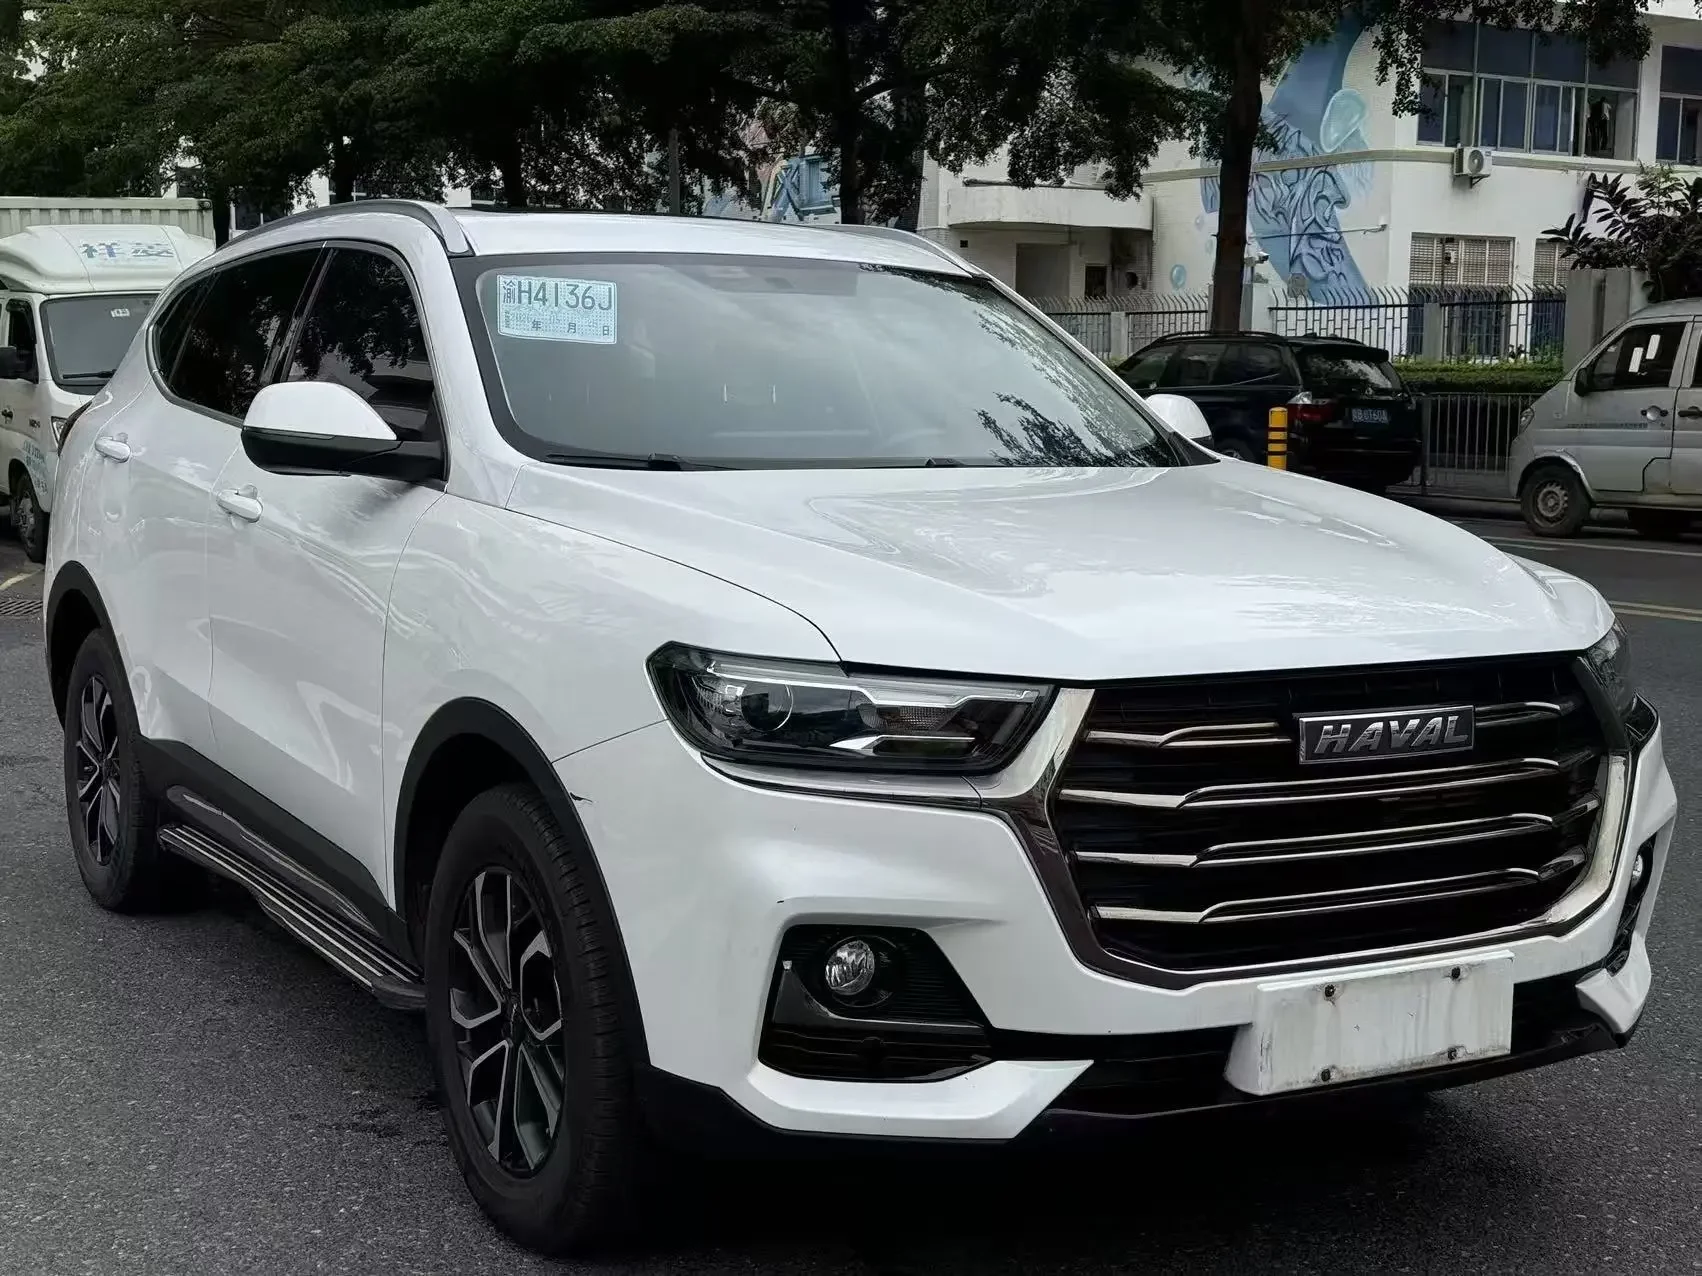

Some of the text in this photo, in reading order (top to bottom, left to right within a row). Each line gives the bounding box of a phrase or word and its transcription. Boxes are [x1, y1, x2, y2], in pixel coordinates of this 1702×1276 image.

[503, 280, 612, 311] 渝H4136J
[531, 319, 542, 331] 年
[567, 322, 577, 334] 月
[602, 325, 610, 336] 日
[1314, 715, 1468, 754] HAVAL
